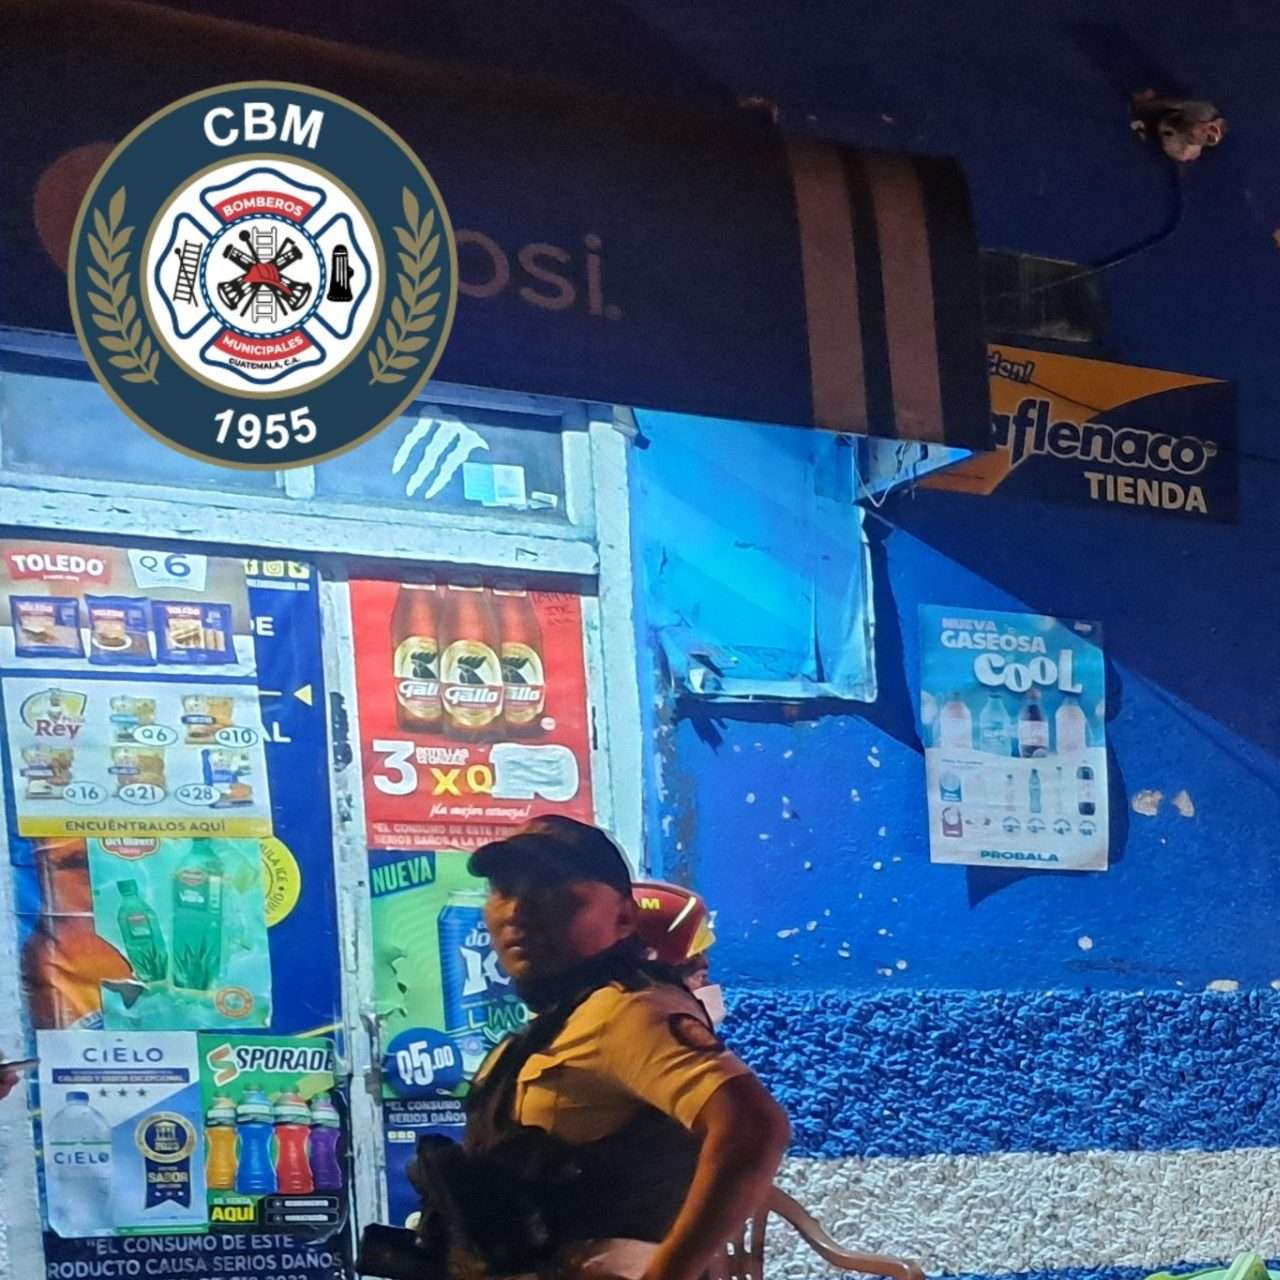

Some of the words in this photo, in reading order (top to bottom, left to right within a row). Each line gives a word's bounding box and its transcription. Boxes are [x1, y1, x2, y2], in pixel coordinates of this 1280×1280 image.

[1084, 471, 1208, 514] TIENDA
[11, 553, 105, 577] TOLEDO
[164, 553, 192, 578] 6
[940, 630, 1047, 653] GASEOSA
[445, 686, 499, 705] Gallo
[35, 718, 81, 740] Rey
[218, 730, 251, 745] Q10
[372, 739, 419, 796] 3
[65, 786, 99, 801] Q16
[126, 786, 157, 801] Q21
[182, 785, 213, 801] Q28
[371, 855, 433, 895] NUEVA
[83, 1047, 164, 1063] CIELO
[235, 1047, 334, 1072] SPORADE
[54, 1151, 110, 1165] CIELO
[123, 1236, 217, 1254] CONSUMO
[222, 1235, 248, 1250] DE
[251, 1233, 295, 1249] ESTE
[145, 1255, 208, 1275] CAUSA
[213, 1253, 277, 1272] SERIOS
[281, 1249, 344, 1270] DAÑOS
